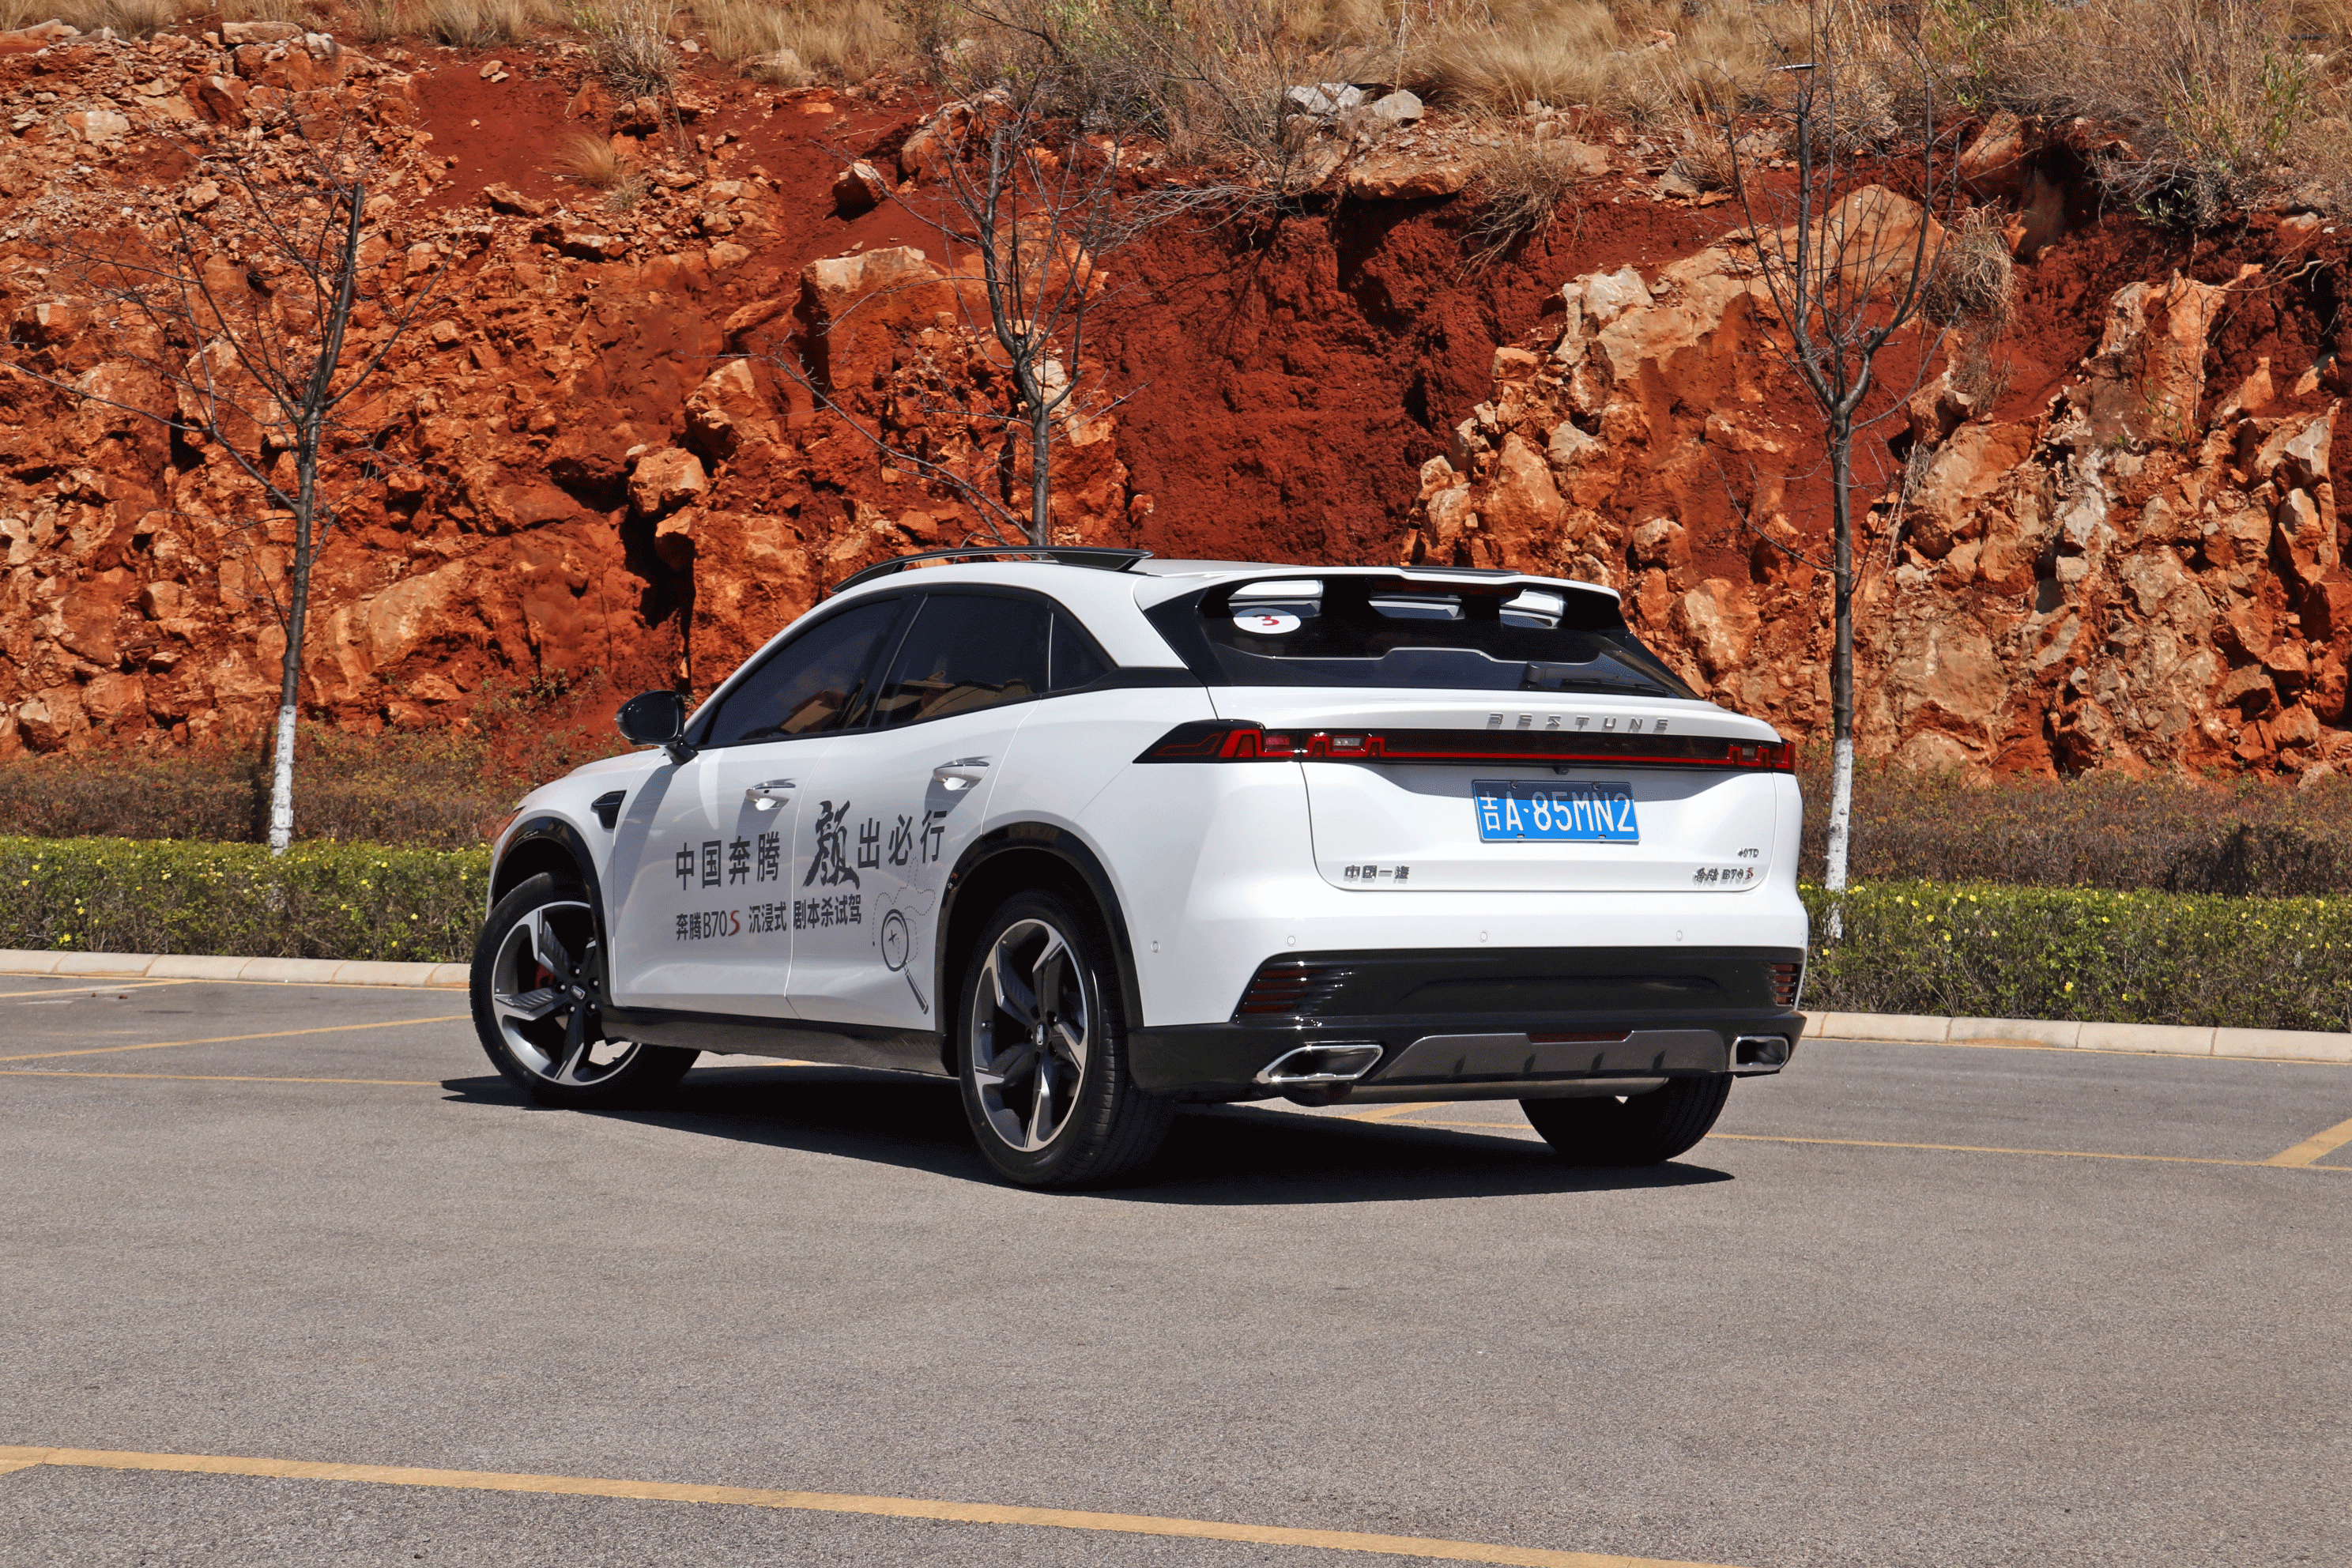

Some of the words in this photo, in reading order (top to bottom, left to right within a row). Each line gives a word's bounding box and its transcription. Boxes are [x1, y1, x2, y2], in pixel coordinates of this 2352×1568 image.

[1489, 713, 1669, 731] BESTUNE
[676, 831, 781, 891] 中国奔腾
